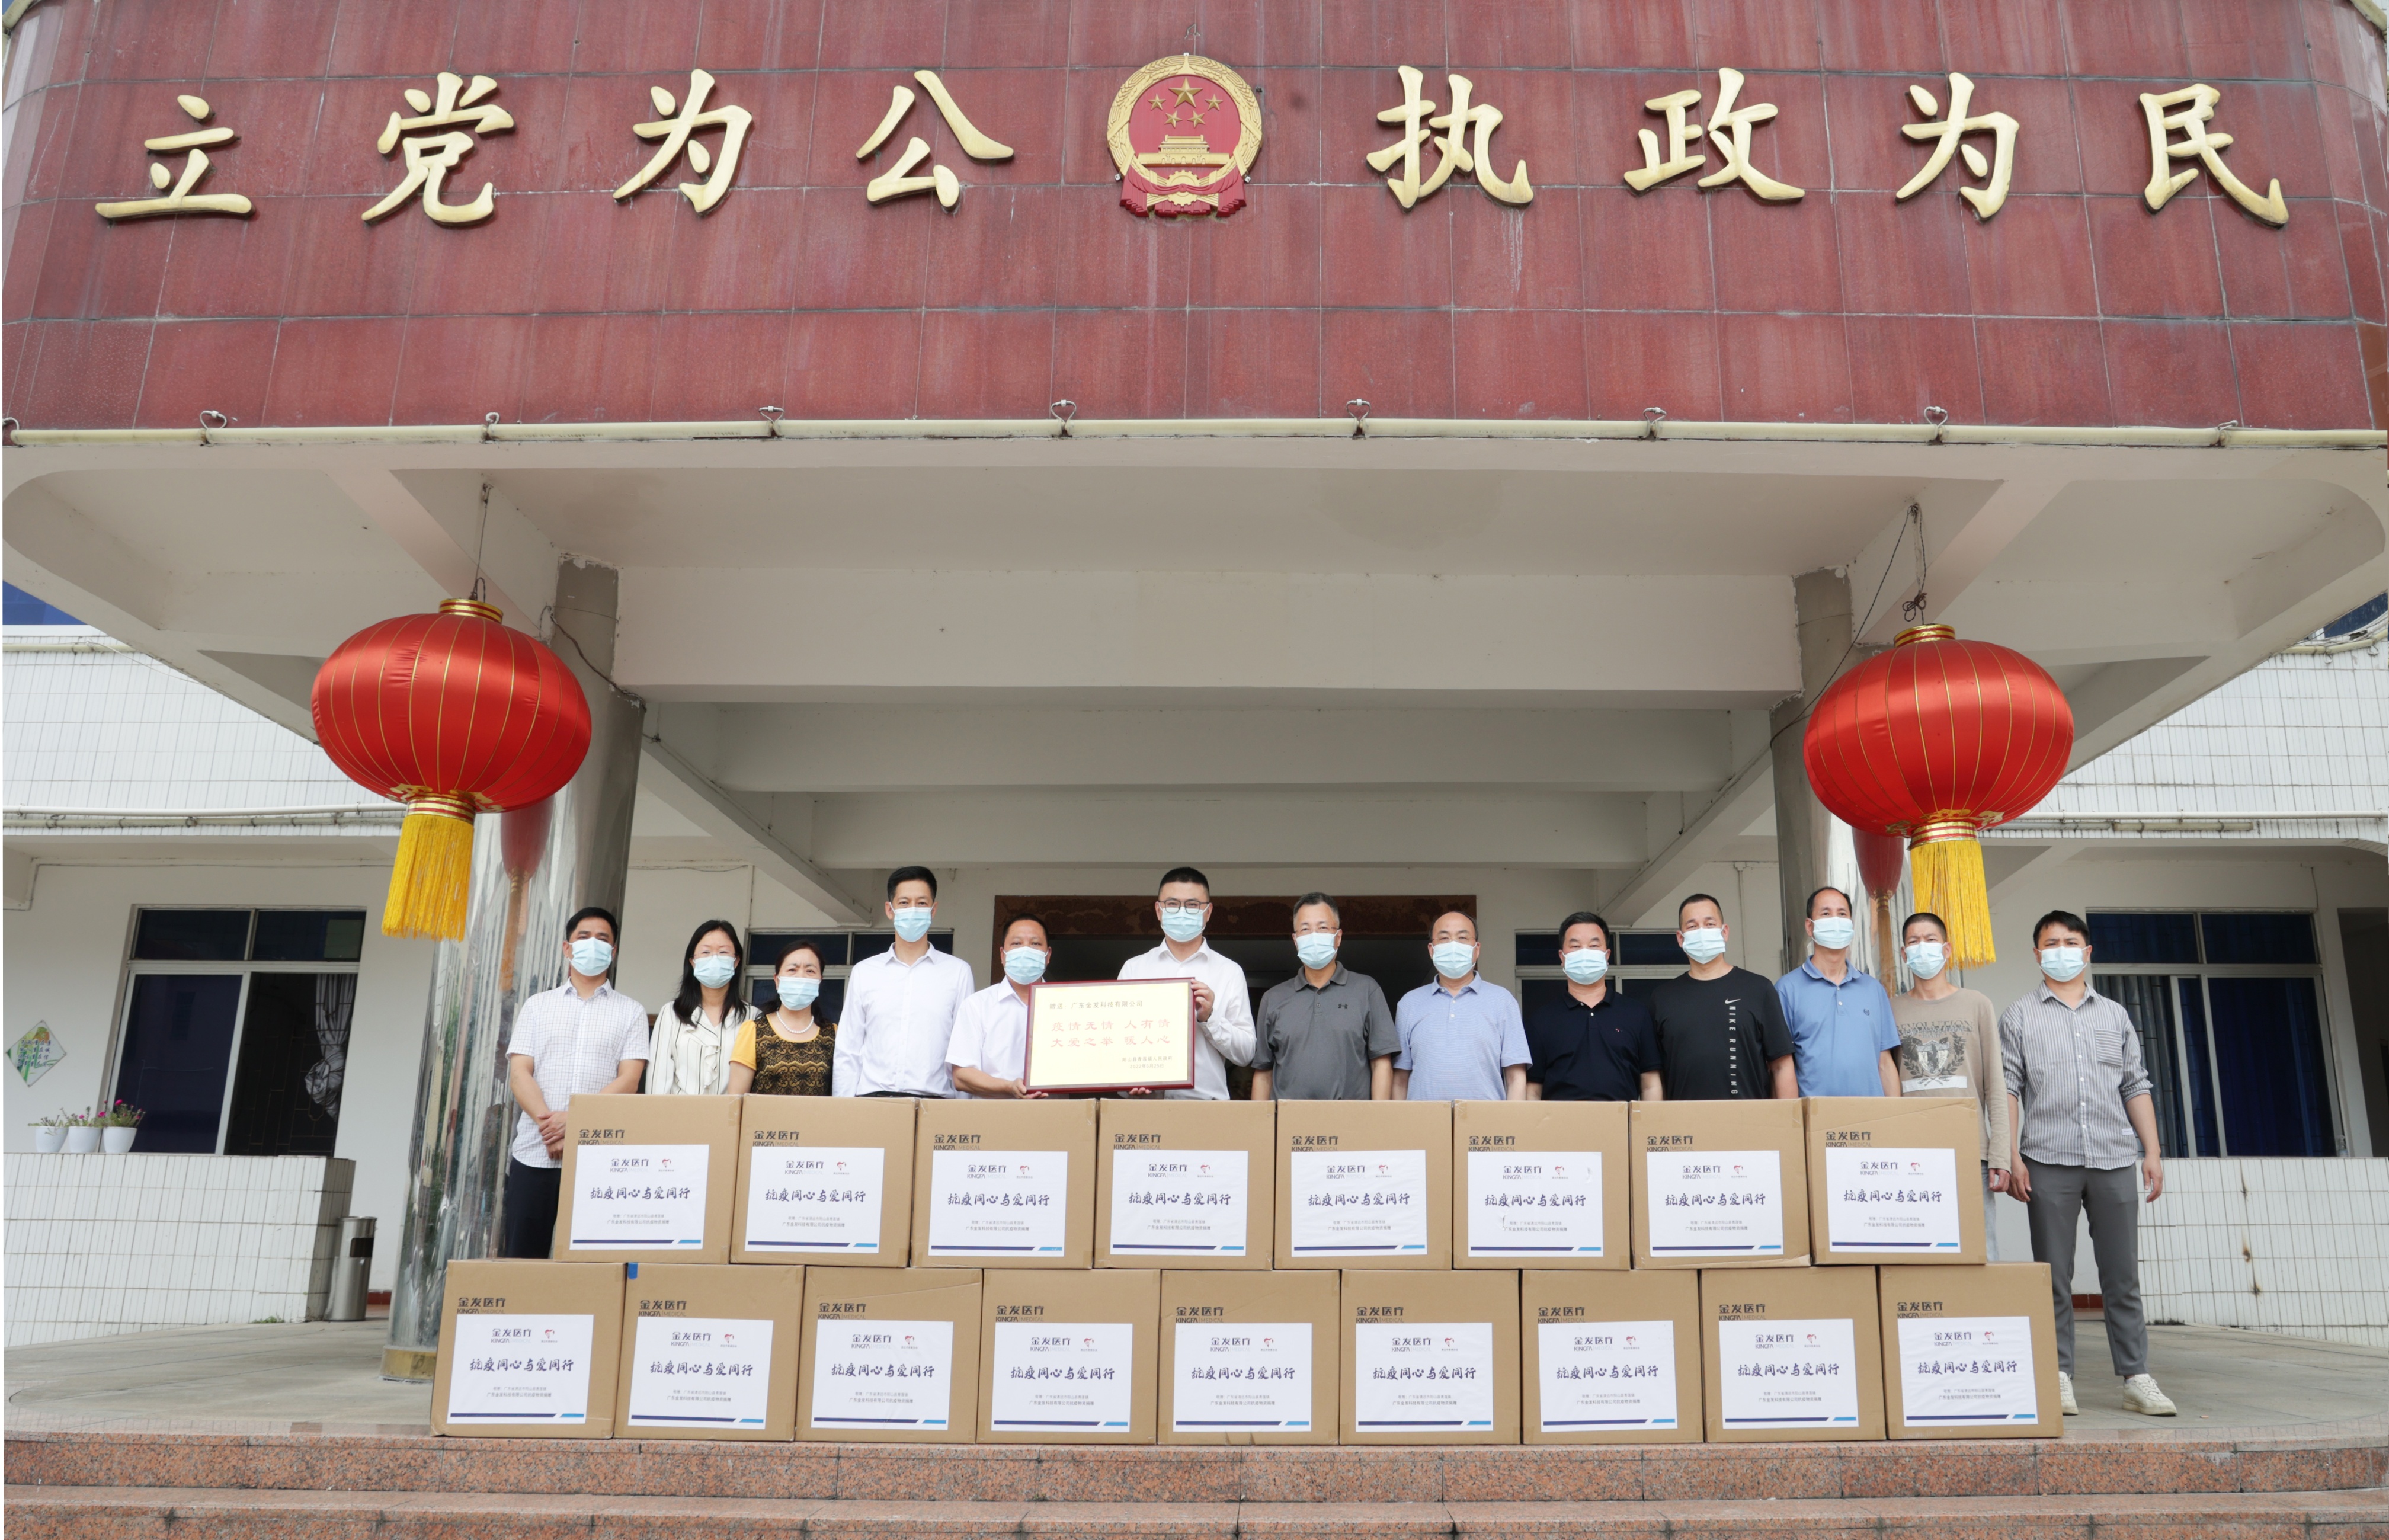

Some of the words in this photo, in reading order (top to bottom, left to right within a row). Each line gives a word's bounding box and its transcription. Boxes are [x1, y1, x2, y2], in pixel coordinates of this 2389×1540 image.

[95, 69, 1014, 224] 立党为公
[1366, 65, 2290, 224] 执政为民
[1052, 1020, 1114, 1032] 疫情无情
[1125, 1018, 1171, 1029] 人有情
[1051, 1036, 1114, 1048] 大爱之举
[1123, 1035, 1171, 1046] 暖人心
[1729, 1039, 1738, 1094] RUNNING
[579, 1129, 625, 1138] 金发医疗
[754, 1131, 799, 1140] 金发医疗
[934, 1134, 981, 1144] 金发医疗
[1115, 1134, 1161, 1143] 金发医疗
[1826, 1131, 1871, 1141] 金发医疗
[1292, 1135, 1338, 1145] 金发医疗
[1469, 1136, 1515, 1145] 金发医疗
[1647, 1135, 1693, 1145] 金发医疗
[590, 1186, 690, 1200] 抗疫同心与爱同行
[765, 1187, 866, 1203] 抗疫同心与爱同行
[1129, 1191, 1231, 1206] 抗疫同心与爱同行
[1843, 1189, 1942, 1203] 抗疫同心与爱同行
[947, 1192, 1049, 1206] 抗疫同心与爱同行
[1308, 1191, 1410, 1207] 抗疫同心与爱同行
[1485, 1193, 1586, 1207] 抗疫同心与爱同行
[1665, 1192, 1766, 1207] 抗疫同心与爱同行
[458, 1297, 505, 1307] 金发医疗
[639, 1299, 686, 1310] 金发医疗
[819, 1302, 866, 1312] 金发医疗
[1897, 1301, 1943, 1311] 金发医疗
[997, 1305, 1044, 1315] 金发医疗
[1176, 1307, 1223, 1315] 金发医疗
[1357, 1307, 1403, 1315] 金发医疗
[1538, 1306, 1584, 1317] 金发医疗
[1719, 1304, 1765, 1314] 金发医疗
[492, 1328, 531, 1337] 金发医疗
[671, 1332, 711, 1341] 金发医疗
[1755, 1334, 1794, 1342] 金发医疗
[1933, 1331, 1972, 1340] 金发医疗
[852, 1334, 891, 1343] 金发医疗
[1031, 1337, 1070, 1345] 金发医疗
[1574, 1336, 1613, 1345] 金发医疗
[469, 1357, 574, 1372] 抗疫同心与爱同行
[649, 1360, 753, 1377] 抗疫同心与爱同行
[831, 1362, 934, 1378] 抗疫同心与爱同行
[1738, 1362, 1839, 1377] 抗疫同心与爱同行
[1917, 1359, 2017, 1375] 抗疫同心与爱同行
[1010, 1365, 1115, 1380] 抗疫同心与爱同行
[1191, 1366, 1295, 1380] 抗疫同心与爱同行
[1373, 1365, 1476, 1380] 抗疫同心与爱同行
[1556, 1363, 1658, 1380] 抗疫同心与爱同行
